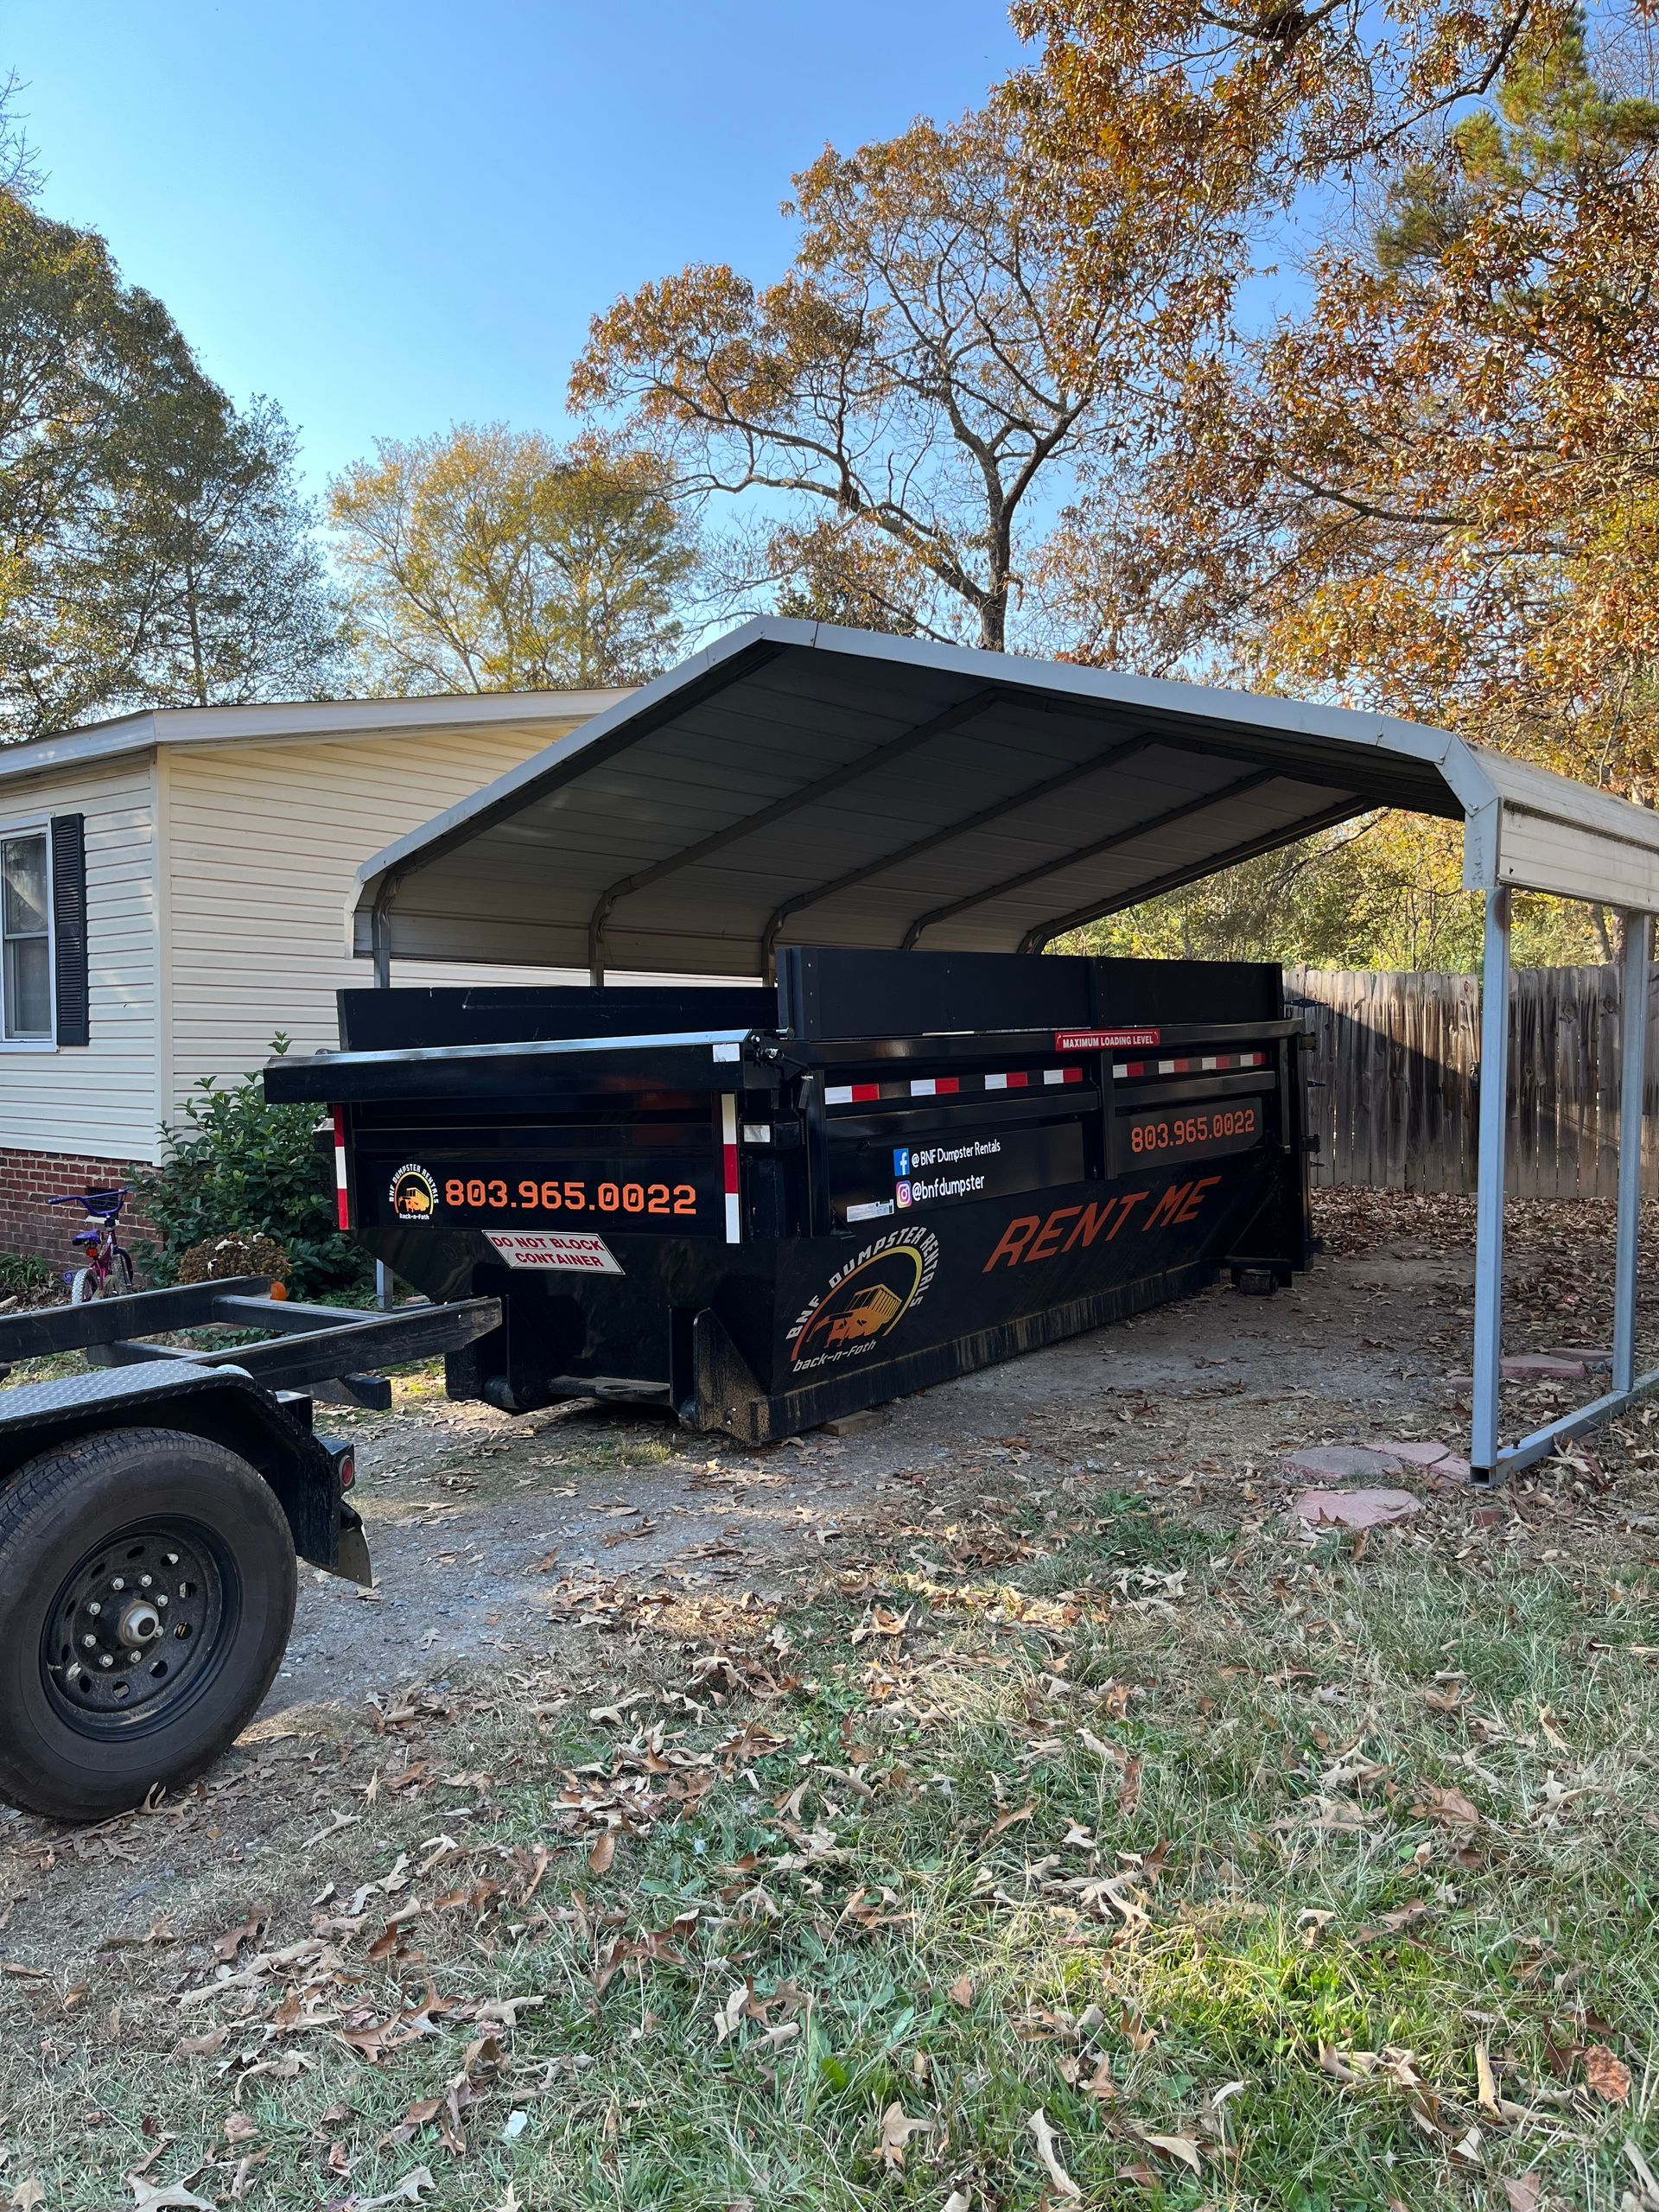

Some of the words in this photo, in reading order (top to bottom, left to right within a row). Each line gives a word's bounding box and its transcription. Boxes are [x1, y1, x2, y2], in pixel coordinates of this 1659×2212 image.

[1063, 1038, 1099, 1048] MAXIMUM
[1101, 1036, 1131, 1046] LOADING
[1133, 1035, 1154, 1045] LEVEL
[1131, 1109, 1255, 1153] 803.965.0022
[921, 1149, 936, 1166] BNF
[938, 1146, 973, 1163] Dumpster
[976, 1138, 1001, 1156] Rentals
[392, 1163, 421, 1184] DUMPSTER
[422, 1168, 439, 1204] RENTALS
[445, 1179, 696, 1215] 803.965.0022
[912, 1175, 984, 1201] @bnfdumpster
[982, 1191, 1150, 1273] RENT
[1142, 1176, 1221, 1231] ME
[491, 1236, 512, 1248] DO
[518, 1237, 546, 1249] NOT
[552, 1238, 605, 1251] BLOCK
[516, 1253, 604, 1267] CONTAINER
[785, 1295, 820, 1339] BNF
[829, 1226, 927, 1288] DUMPSTER
[909, 1232, 939, 1307] RENTALS
